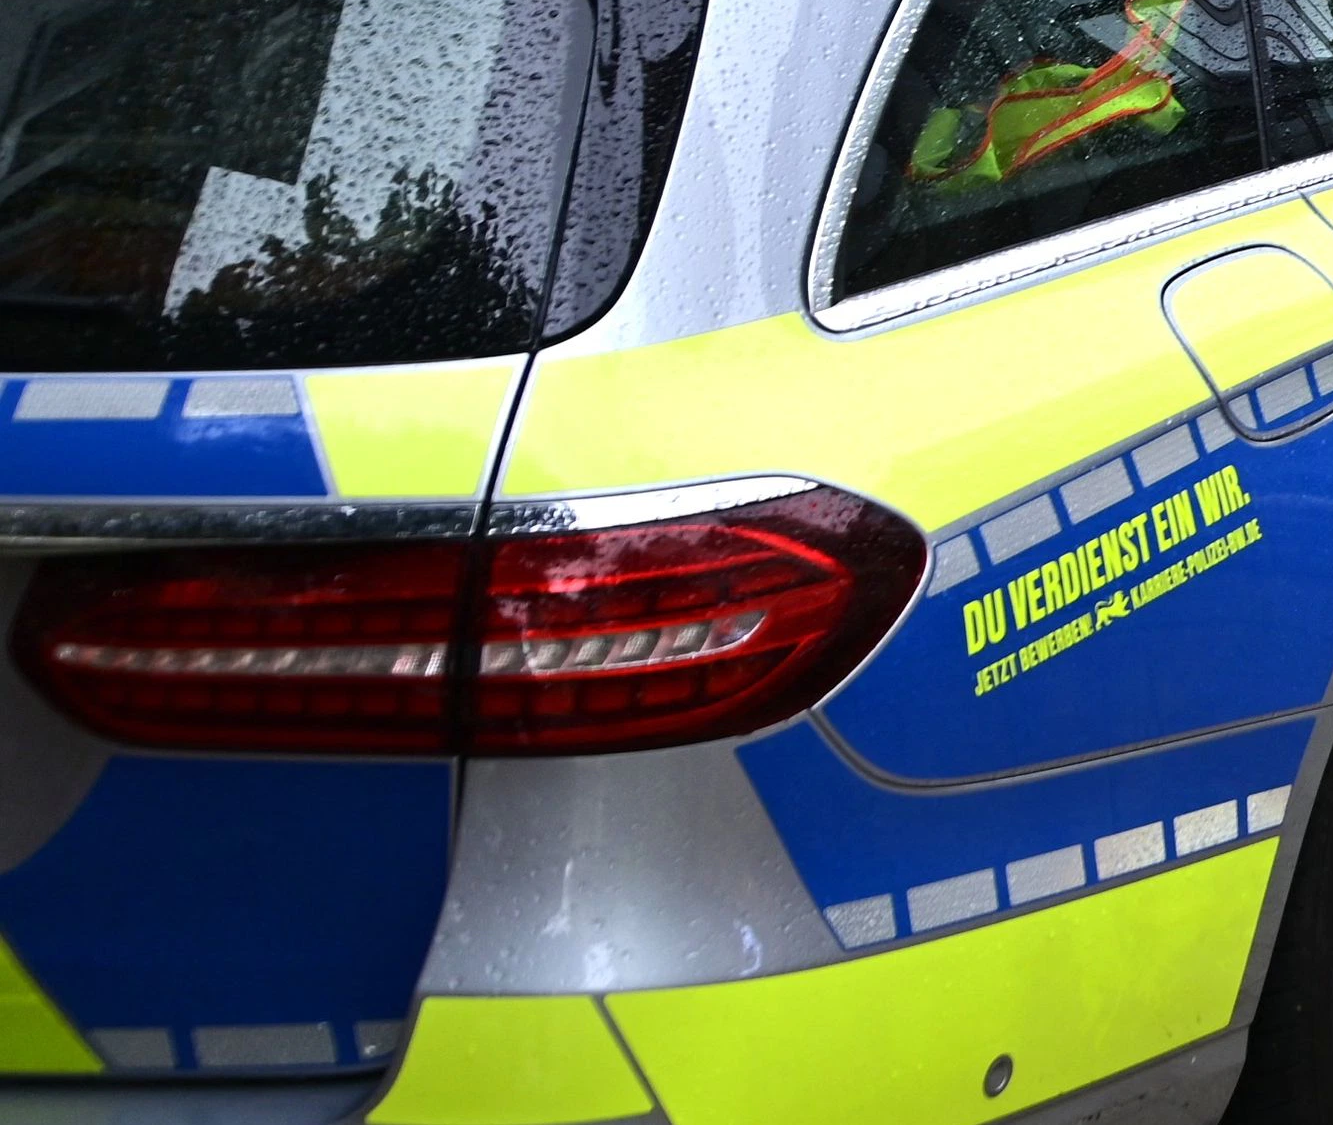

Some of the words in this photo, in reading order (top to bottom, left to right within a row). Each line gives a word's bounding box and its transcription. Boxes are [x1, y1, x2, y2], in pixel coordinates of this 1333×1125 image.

[962, 588, 1007, 657] DU
[1007, 512, 1151, 631] VERDIENST
[1150, 489, 1198, 553] EIN
[1193, 464, 1251, 527] WIR.
[974, 653, 1020, 697] JETZT
